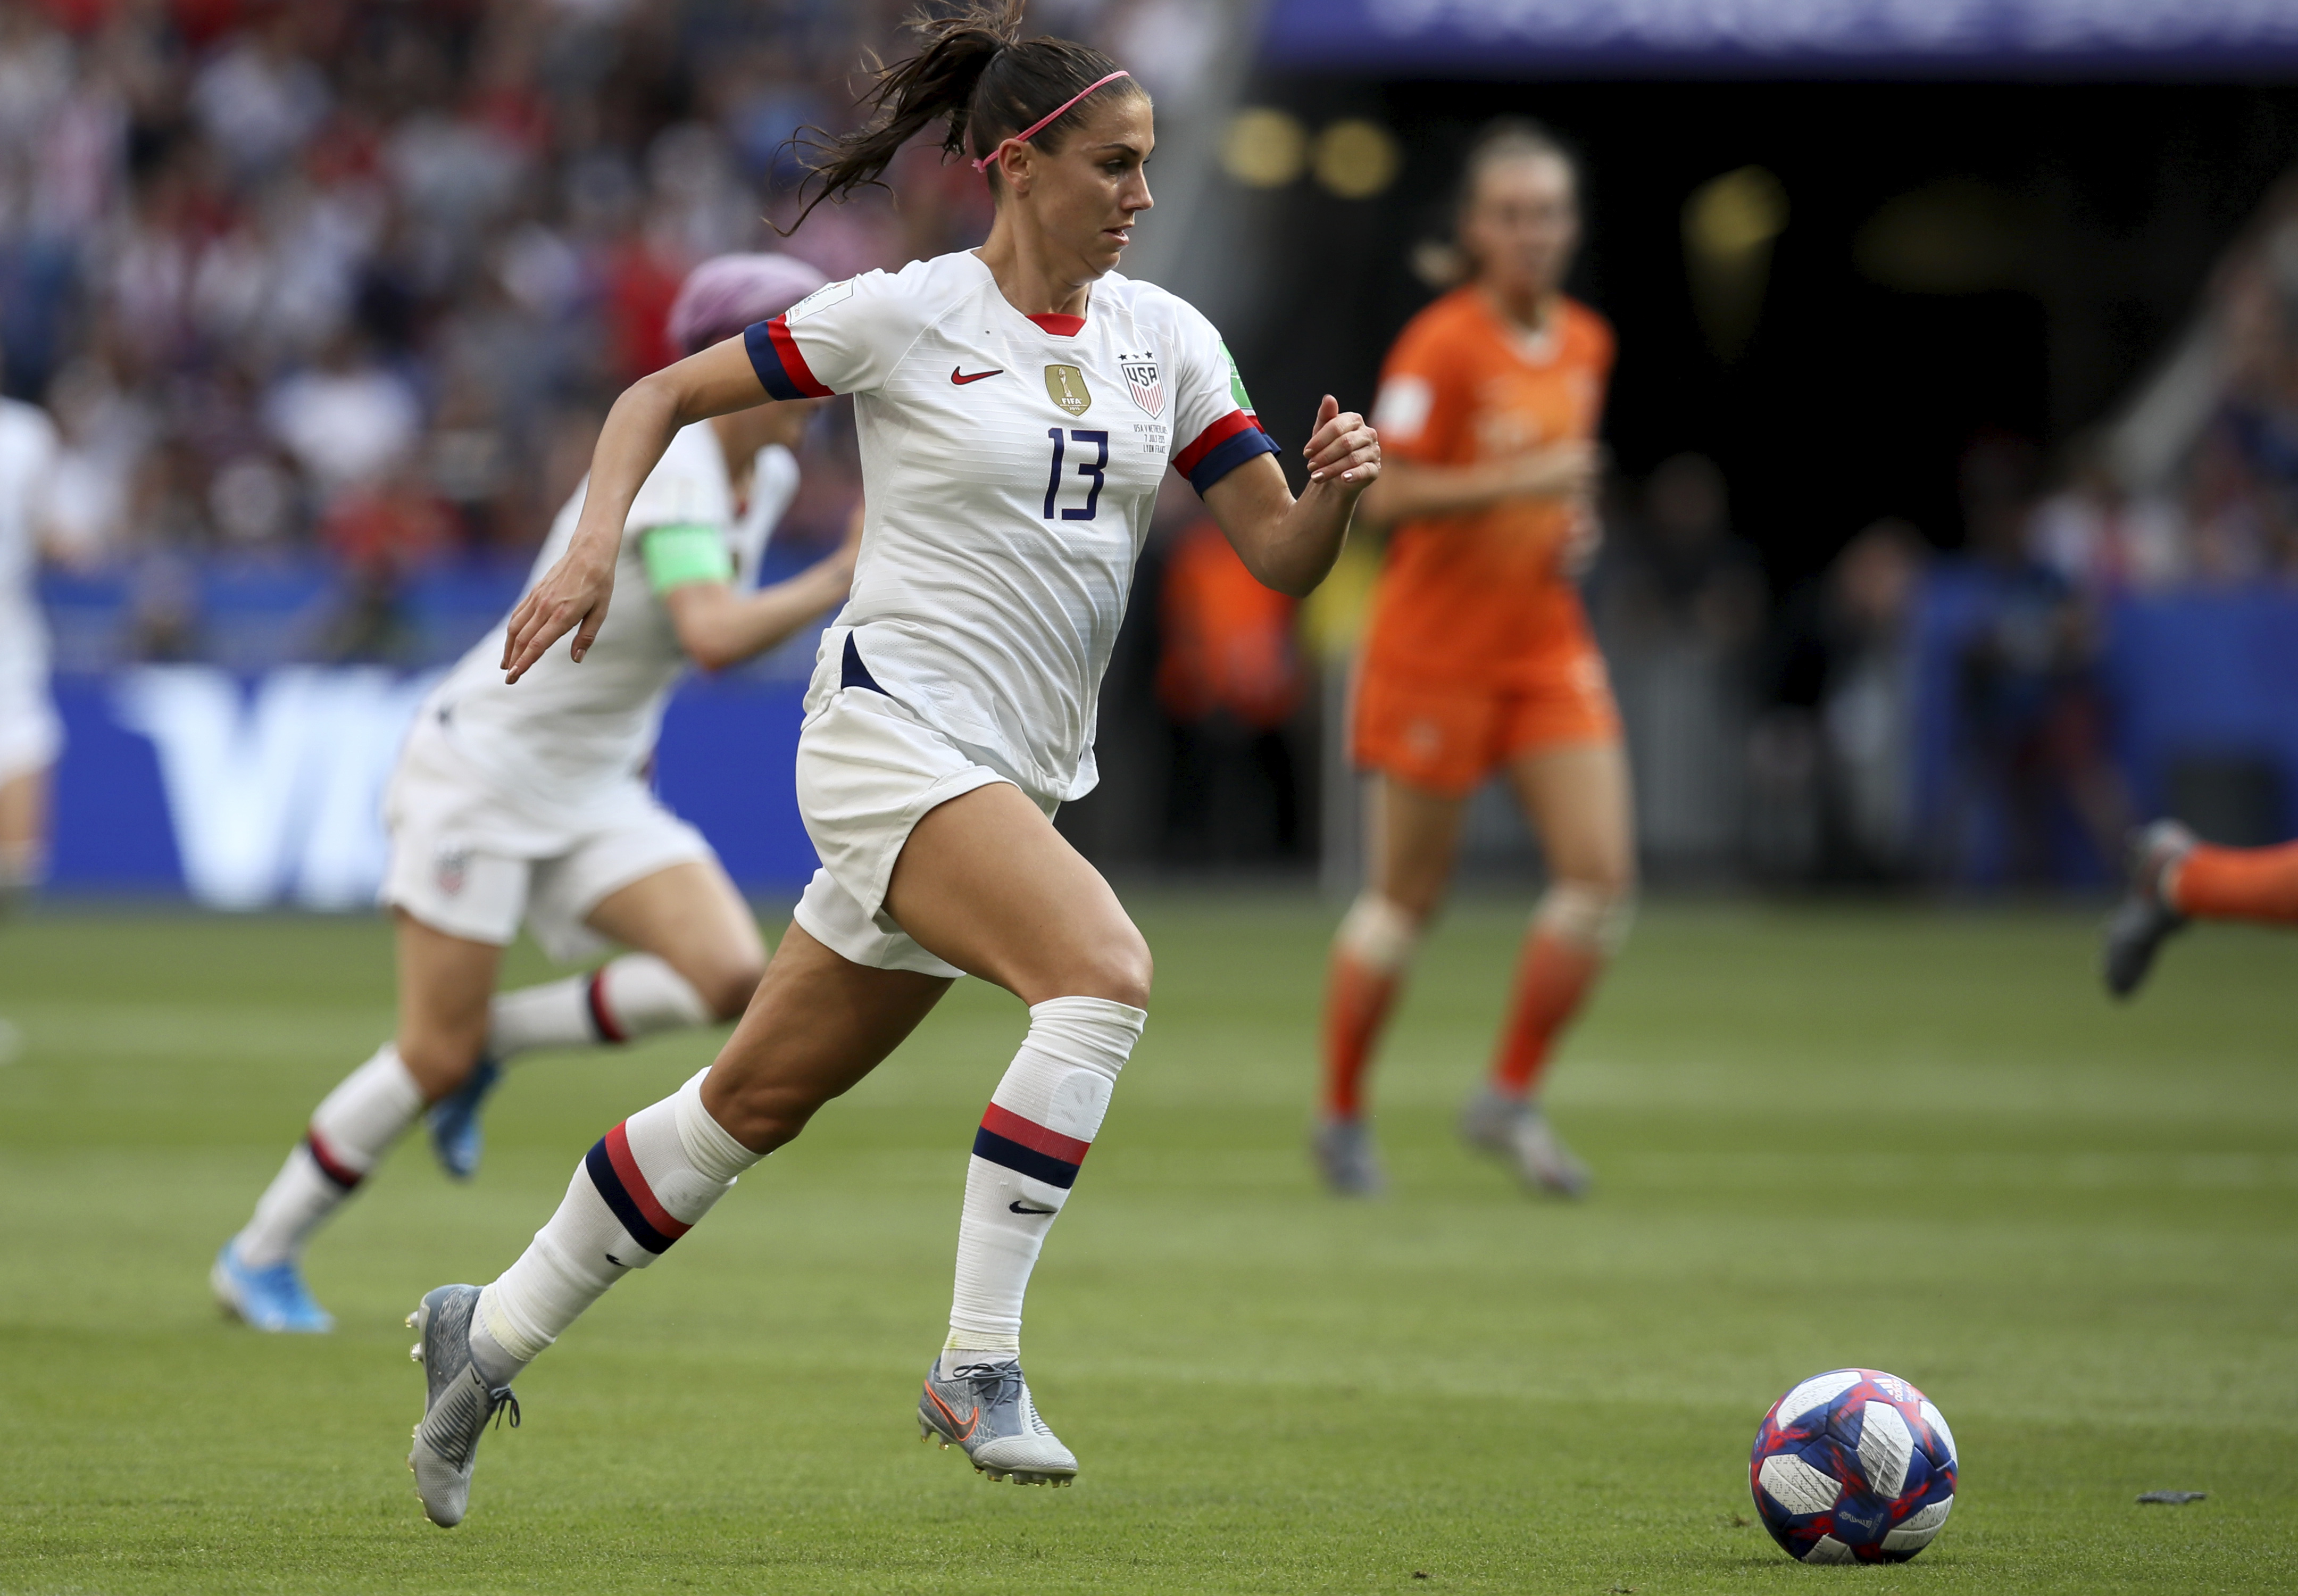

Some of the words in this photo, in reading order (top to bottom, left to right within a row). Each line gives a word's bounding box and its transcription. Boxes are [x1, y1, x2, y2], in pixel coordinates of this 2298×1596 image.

[1126, 367, 1158, 387] USA
[1133, 424, 1144, 433] USA
[1044, 428, 1109, 521] 13
